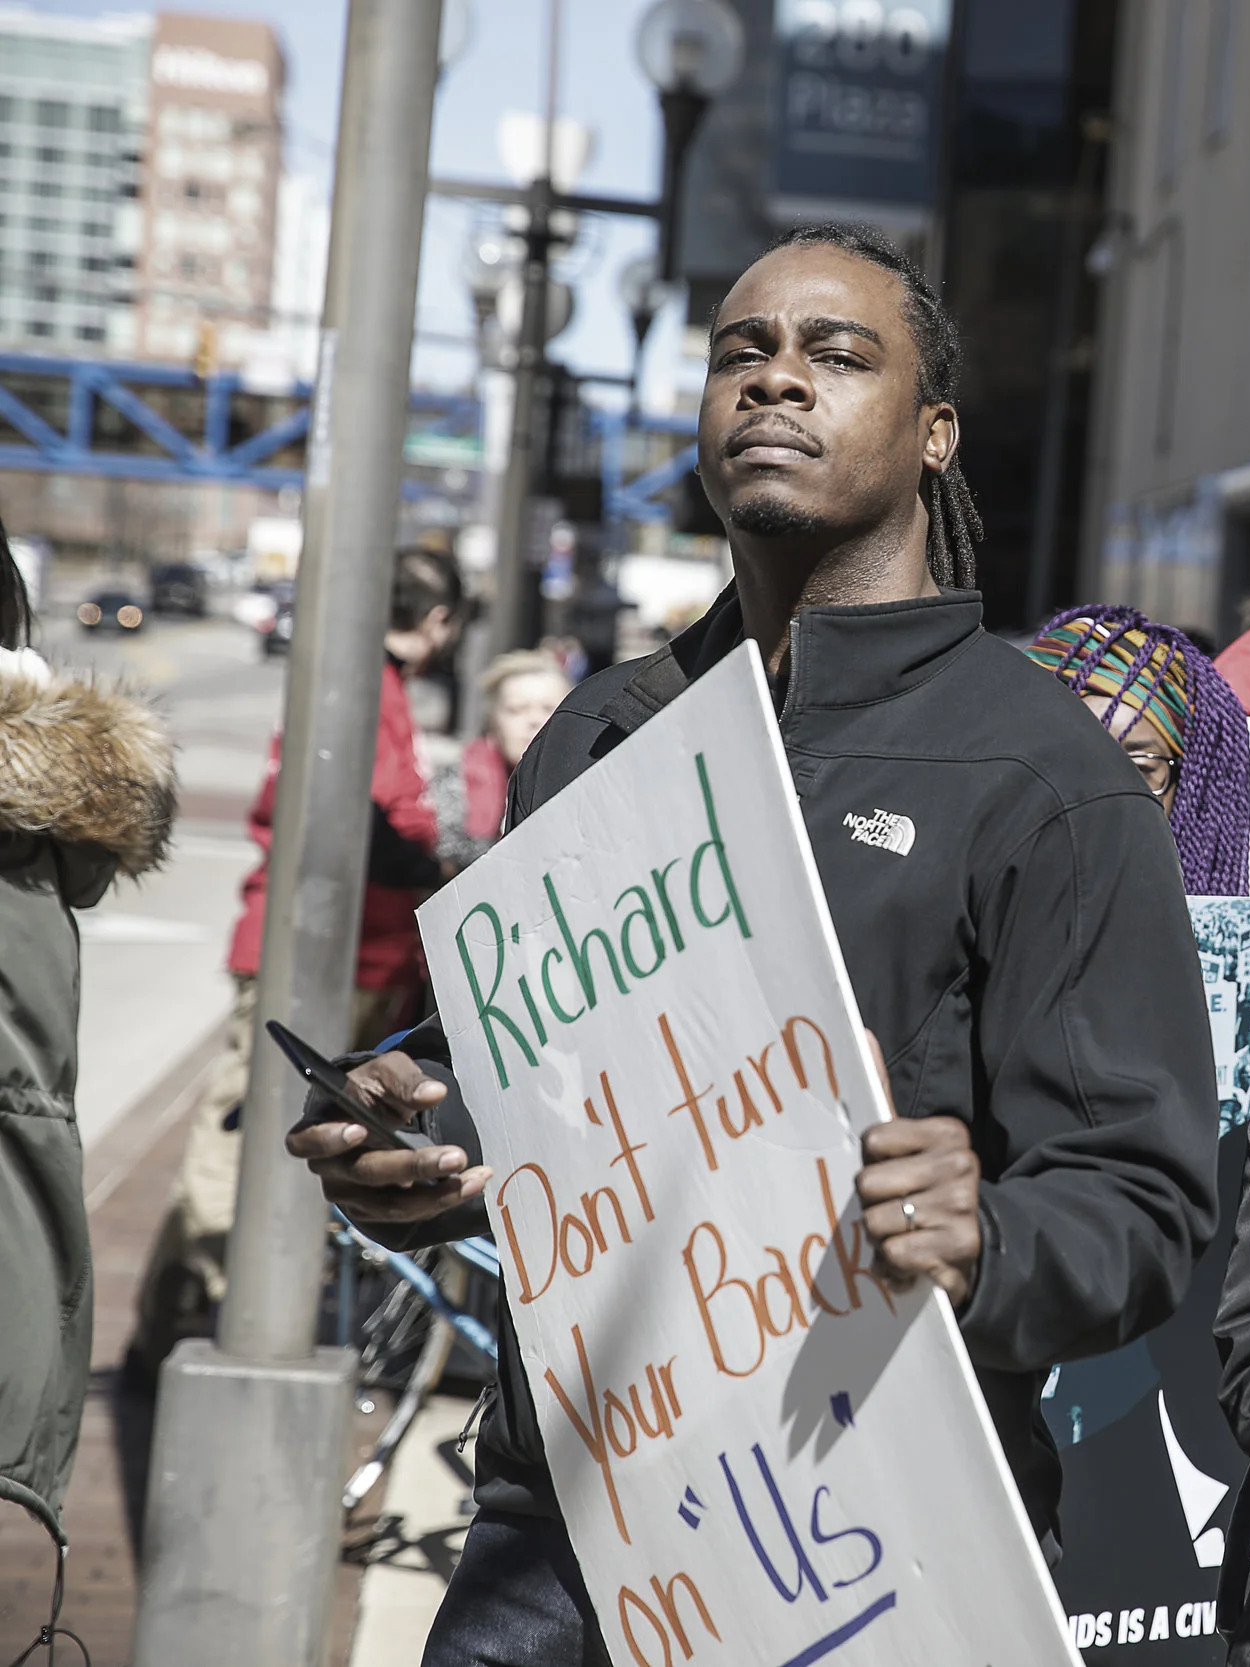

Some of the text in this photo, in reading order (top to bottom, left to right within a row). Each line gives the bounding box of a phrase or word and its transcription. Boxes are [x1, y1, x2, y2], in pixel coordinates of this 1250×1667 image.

[842, 812, 892, 836] NORTH
[850, 829, 888, 848] FACE
[873, 808, 900, 827] THE
[455, 752, 754, 1091] Richard
[496, 1012, 840, 1305] Don't turn
[544, 1157, 899, 1546] Your Back
[618, 1571, 723, 1667] on
[1117, 1607, 1146, 1645] IS
[1148, 1605, 1170, 1642] A
